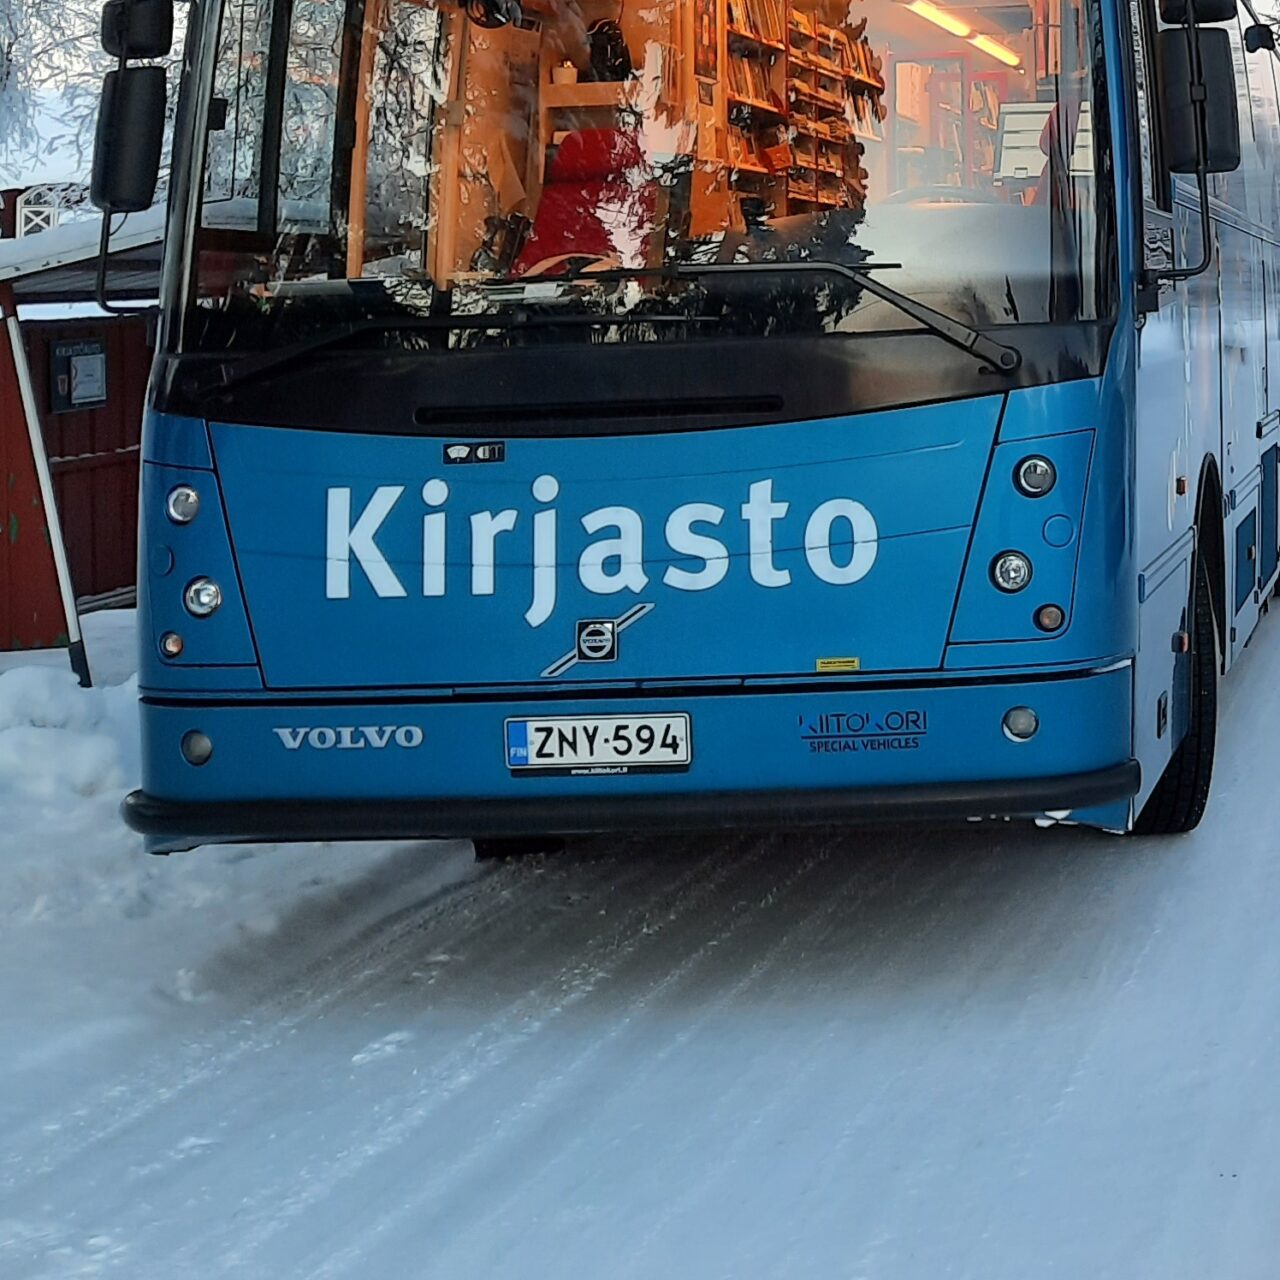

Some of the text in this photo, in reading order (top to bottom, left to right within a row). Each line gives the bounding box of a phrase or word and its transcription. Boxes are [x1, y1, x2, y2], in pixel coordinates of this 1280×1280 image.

[325, 474, 880, 629] Kirjasto
[271, 725, 424, 750] VOLVO
[533, 723, 680, 759] ZNY-594
[809, 737, 920, 753] SPECIAL VEHICLES
[509, 746, 528, 758] FIN
